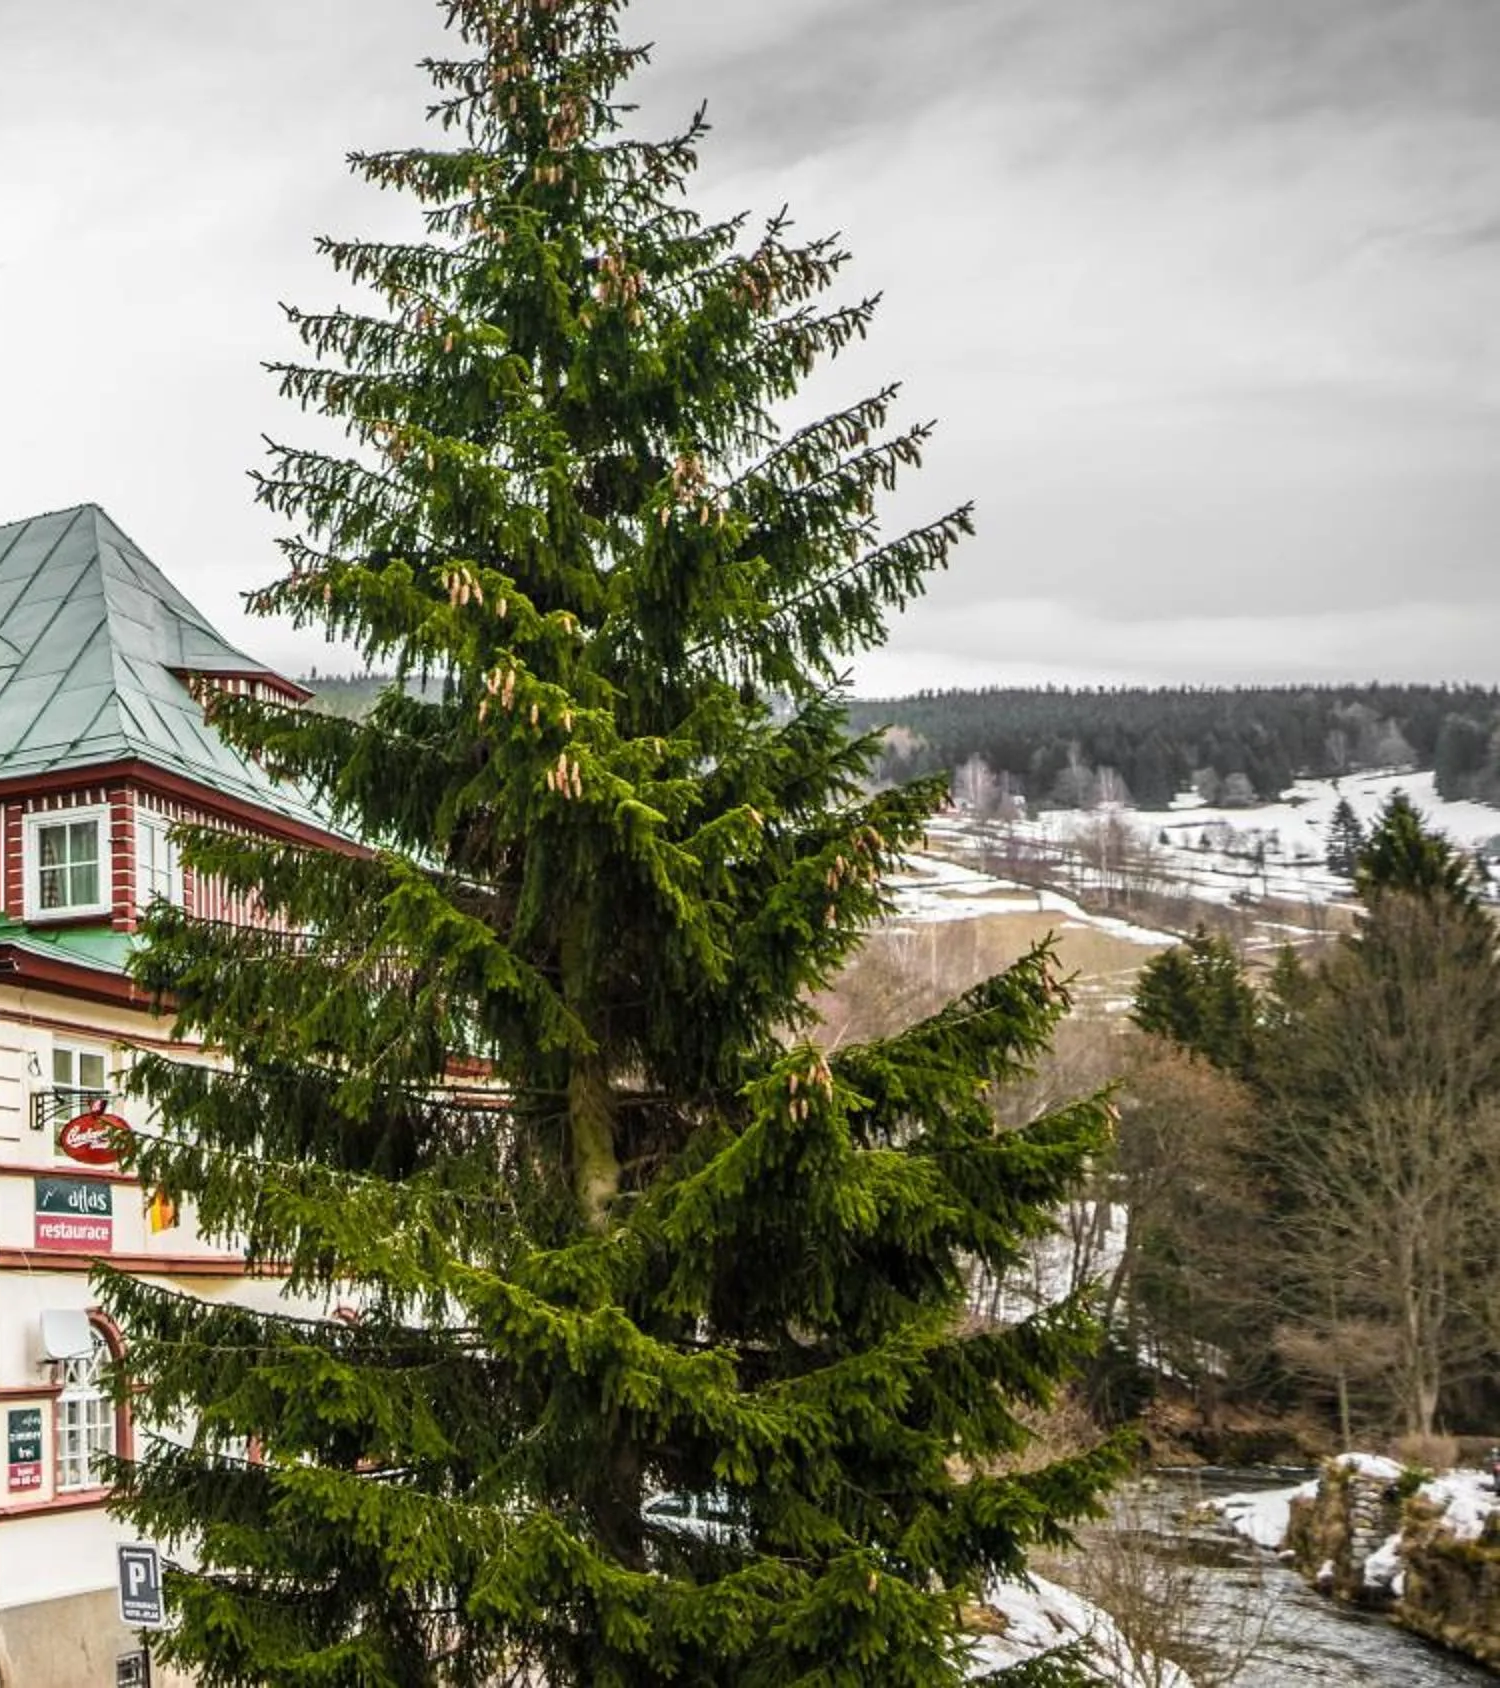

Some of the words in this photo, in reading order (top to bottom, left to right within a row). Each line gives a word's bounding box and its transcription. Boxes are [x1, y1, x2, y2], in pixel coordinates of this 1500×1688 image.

[67, 1185, 108, 1213] atlas
[40, 1222, 110, 1241] restaurace
[128, 1561, 146, 1597] P
